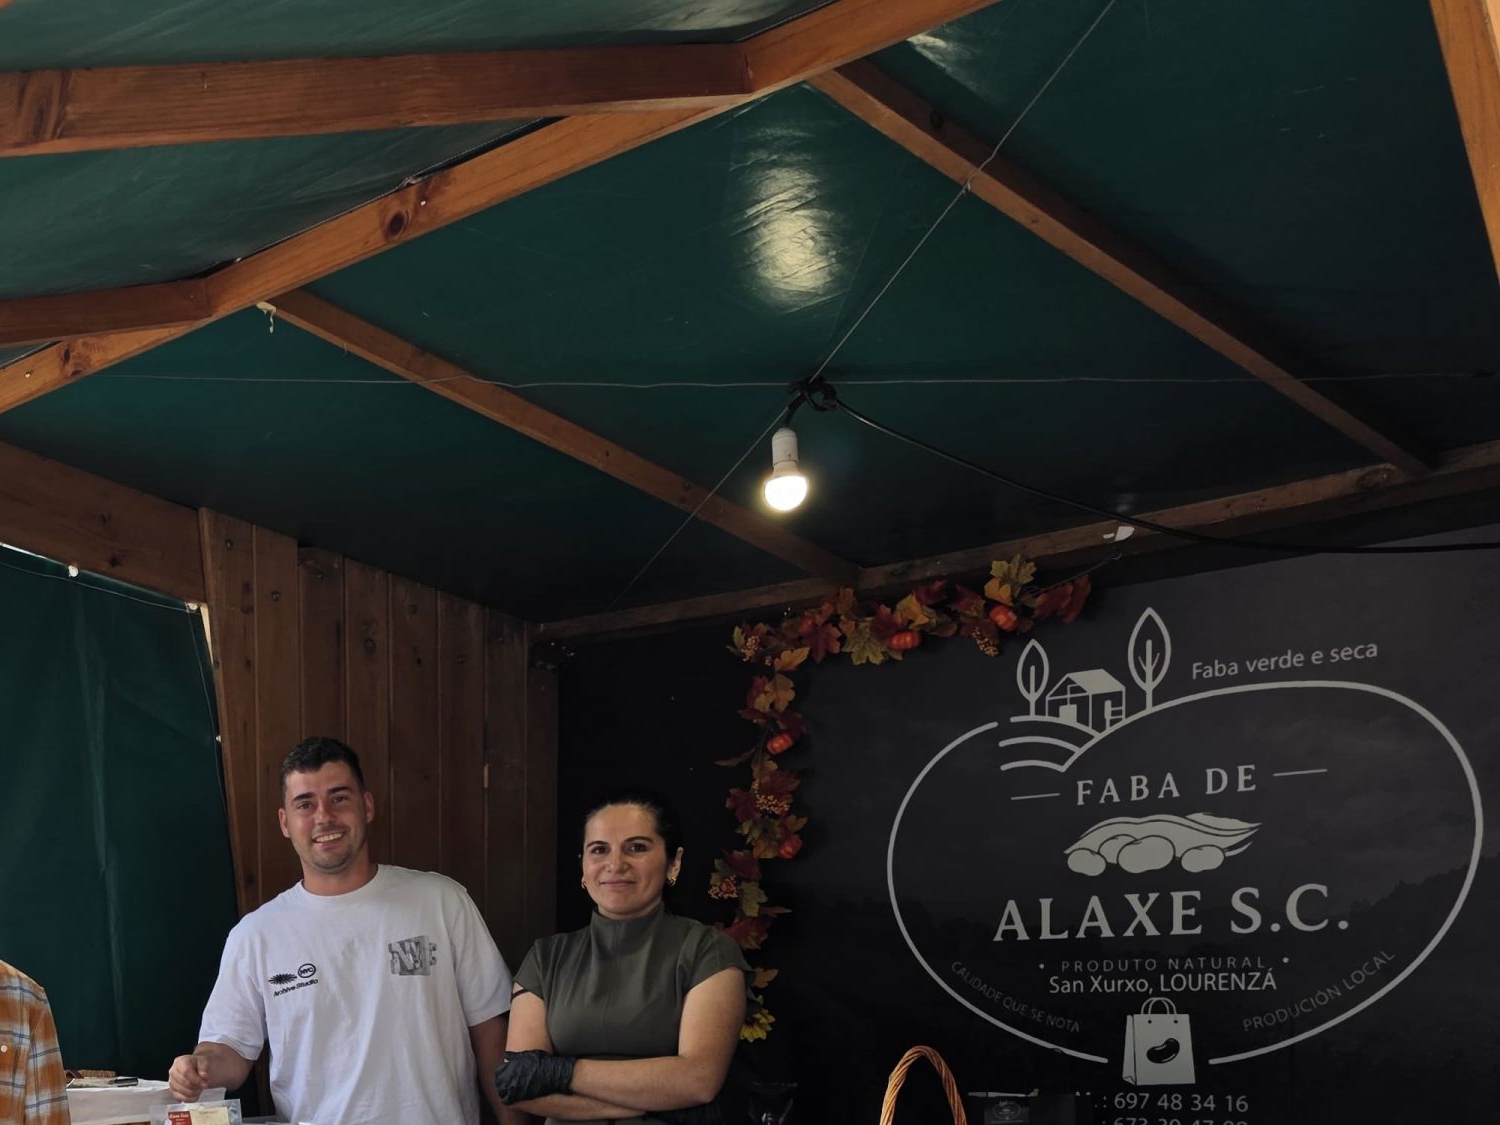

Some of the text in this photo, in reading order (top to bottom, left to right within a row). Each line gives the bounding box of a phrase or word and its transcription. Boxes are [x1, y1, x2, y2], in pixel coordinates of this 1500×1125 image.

[1192, 642, 1379, 681] Faba verde e seca
[1075, 764, 1258, 806] FABA DE
[992, 883, 1350, 943] ALAXE S.C.
[1049, 967, 1278, 995] San Xurxo, LOURENZÁ
[1061, 955, 1267, 973] PRODUTO NATURAL
[1342, 950, 1396, 991] LOCAL
[951, 960, 1080, 1033] CALIDADE QUE SE NOTA
[1113, 1092, 1150, 1110] 697
[1156, 1093, 1183, 1111] 48
[1190, 1094, 1217, 1112] 34
[1225, 1095, 1249, 1113] 16
